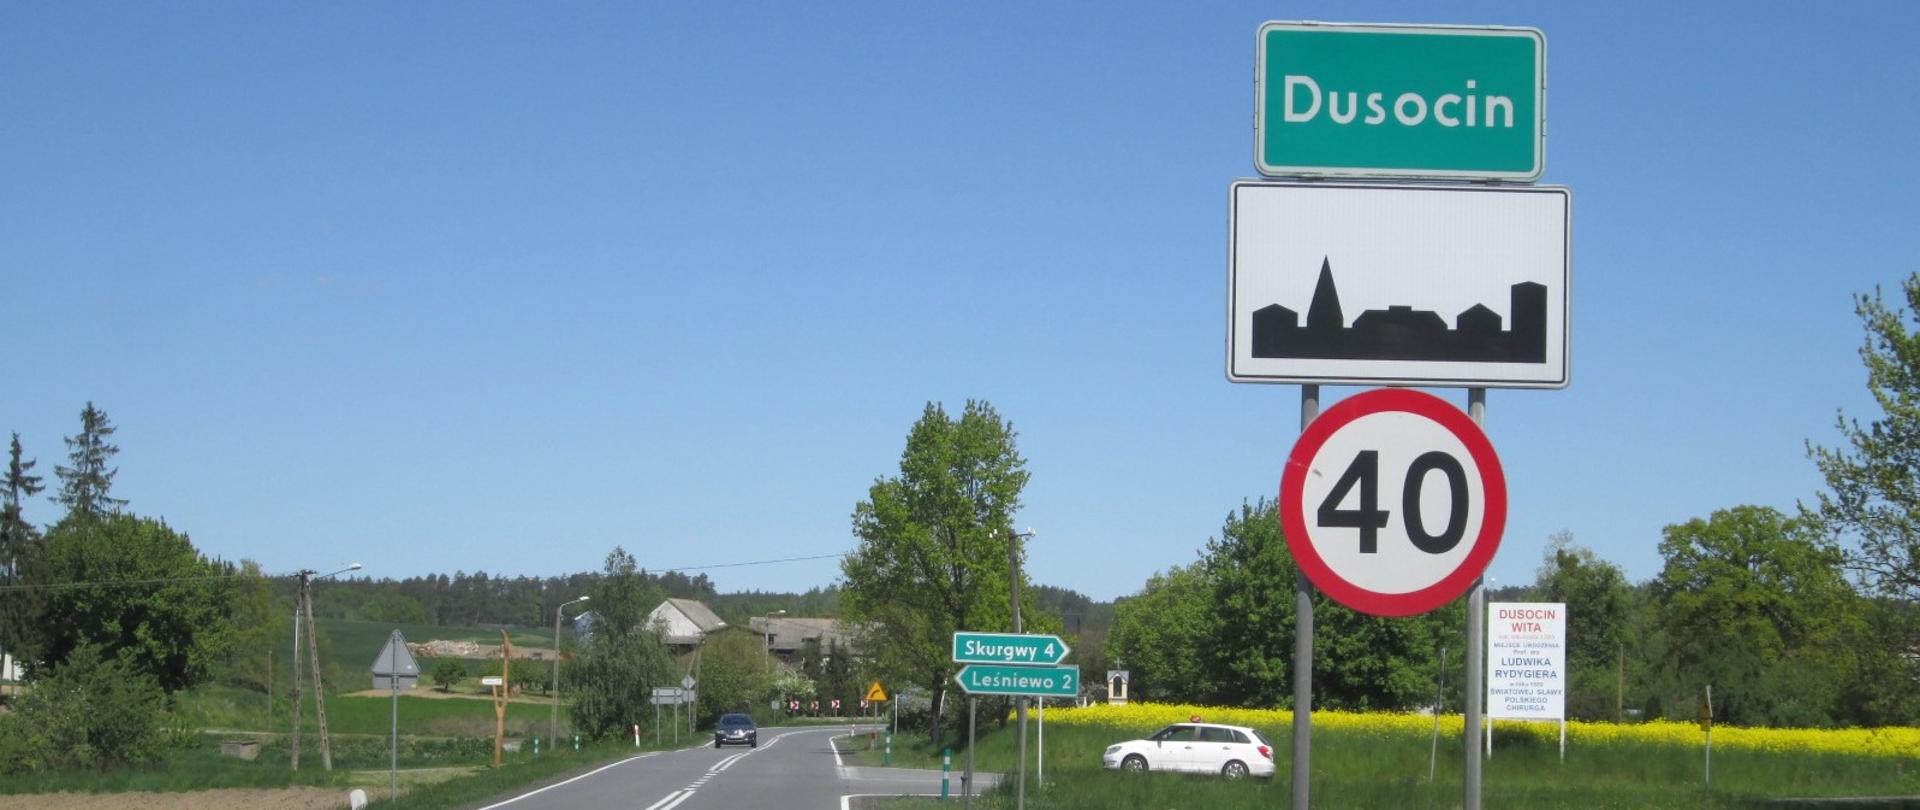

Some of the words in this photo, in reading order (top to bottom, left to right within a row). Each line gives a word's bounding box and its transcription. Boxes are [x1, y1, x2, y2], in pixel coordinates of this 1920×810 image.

[1284, 75, 1514, 128] Dusocin
[1317, 450, 1469, 554] 40
[1499, 609, 1556, 619] DUSOCIN
[1512, 623, 1542, 632] WITA
[965, 640, 1037, 661] Skurgwy
[1044, 643, 1055, 658] 4
[1501, 658, 1551, 666] LUDWIKA
[972, 671, 1054, 688] Leśniewo
[1062, 675, 1072, 689] 2
[1495, 670, 1557, 679] RYDYGIERA
